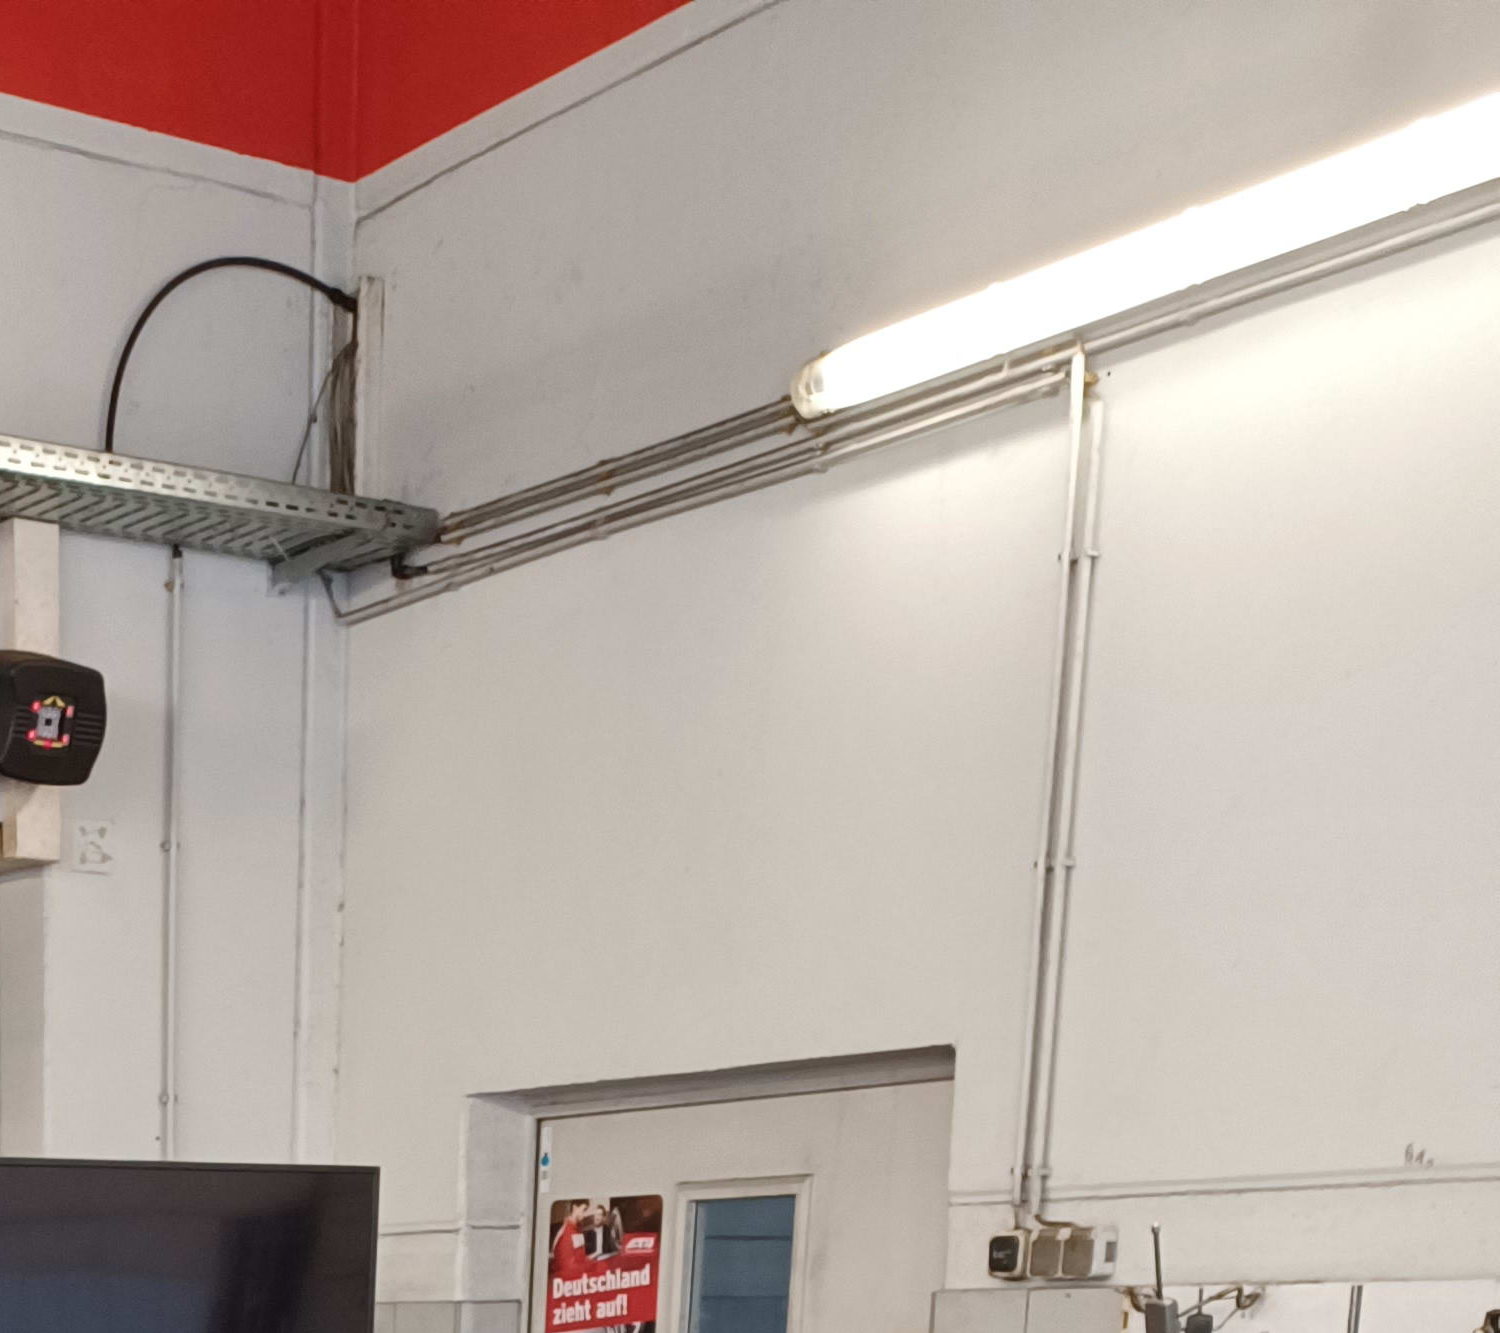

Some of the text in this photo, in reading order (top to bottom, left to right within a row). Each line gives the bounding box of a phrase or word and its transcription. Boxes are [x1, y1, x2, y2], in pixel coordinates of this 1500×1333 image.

[552, 1263, 651, 1299] Deutschland
[552, 1293, 628, 1325] zieht auf!
